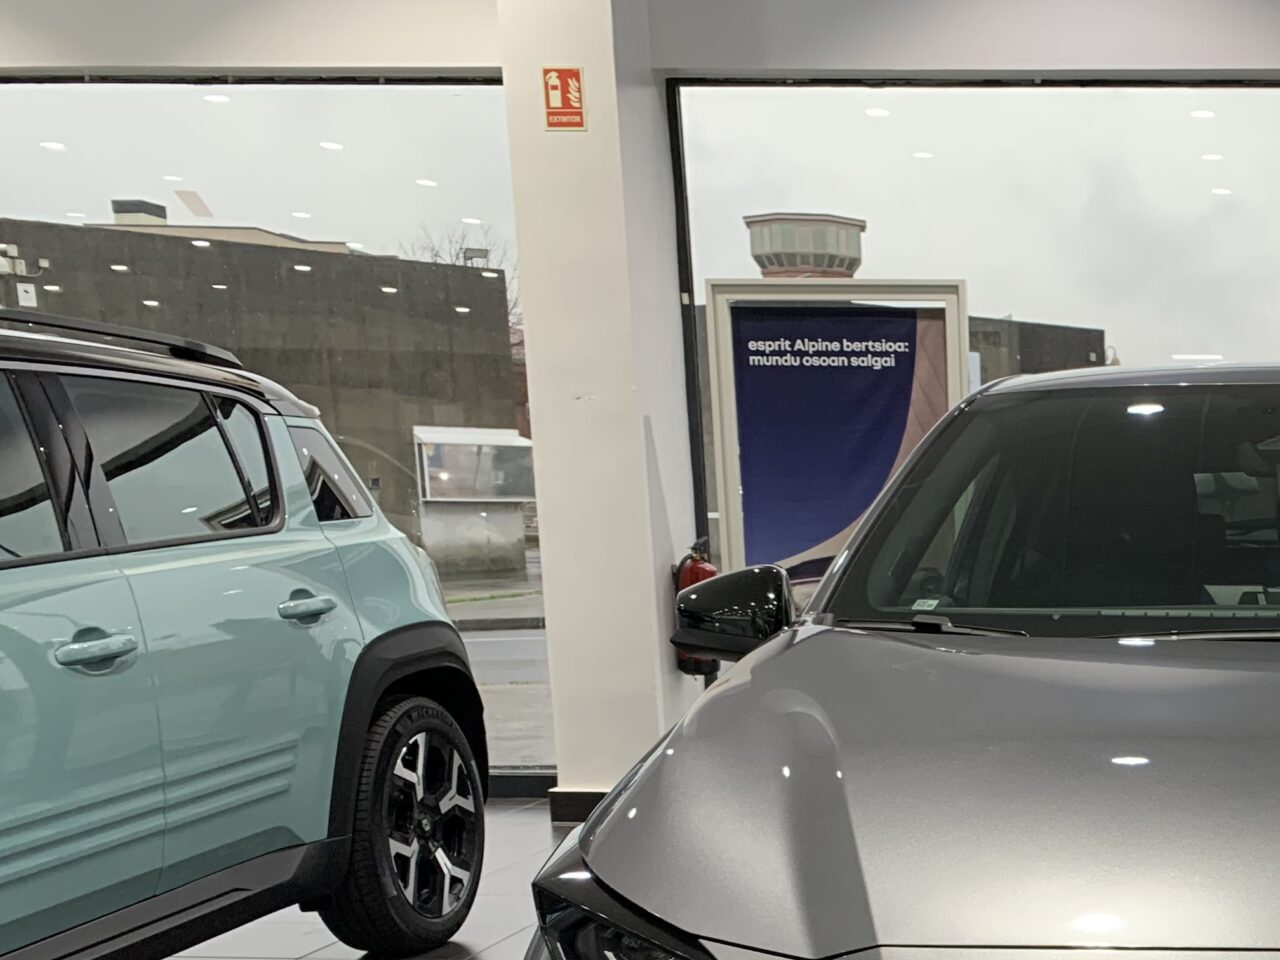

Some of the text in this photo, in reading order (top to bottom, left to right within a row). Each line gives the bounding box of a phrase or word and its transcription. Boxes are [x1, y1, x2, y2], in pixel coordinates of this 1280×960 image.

[549, 115, 581, 123] EXTINTOR
[748, 338, 909, 354] esprit Alpine bertsioa:
[749, 353, 896, 370] mundu osoan salgai
